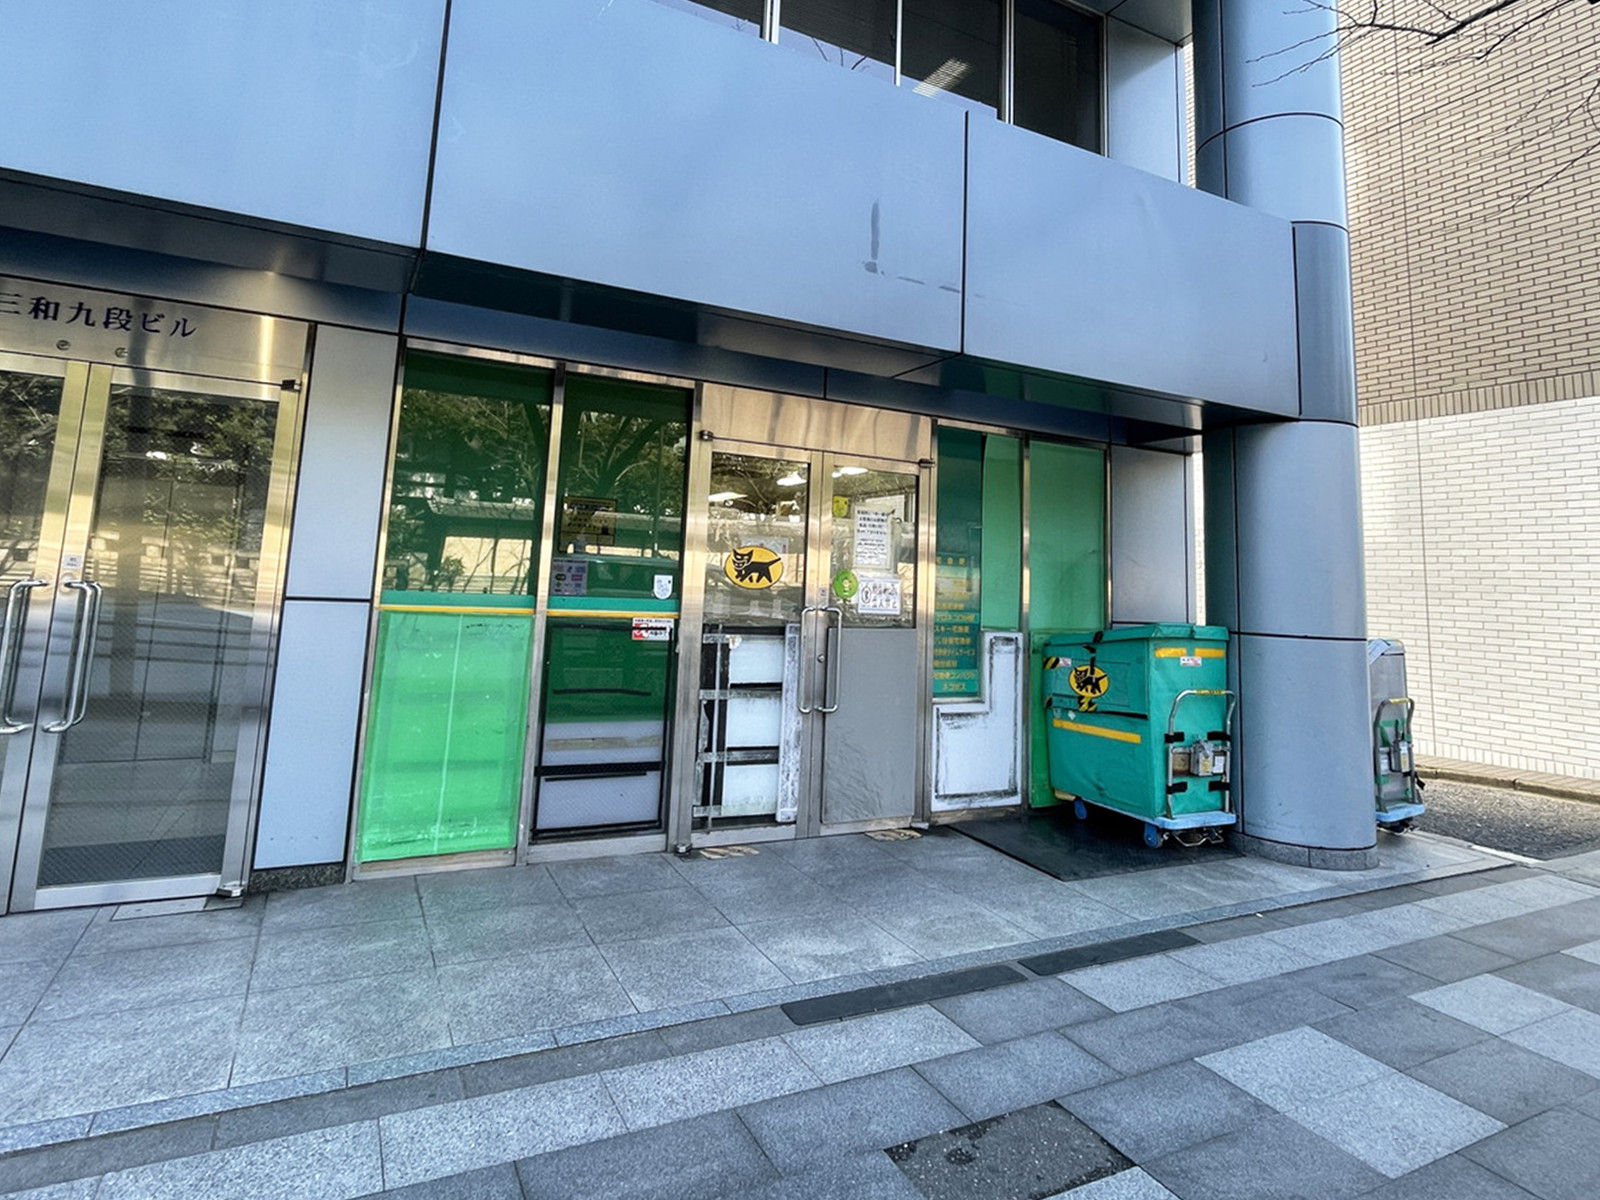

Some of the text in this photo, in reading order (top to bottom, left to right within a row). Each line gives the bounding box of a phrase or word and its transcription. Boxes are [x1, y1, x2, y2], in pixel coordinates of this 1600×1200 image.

[0, 291, 197, 338] 三和九段ビル
